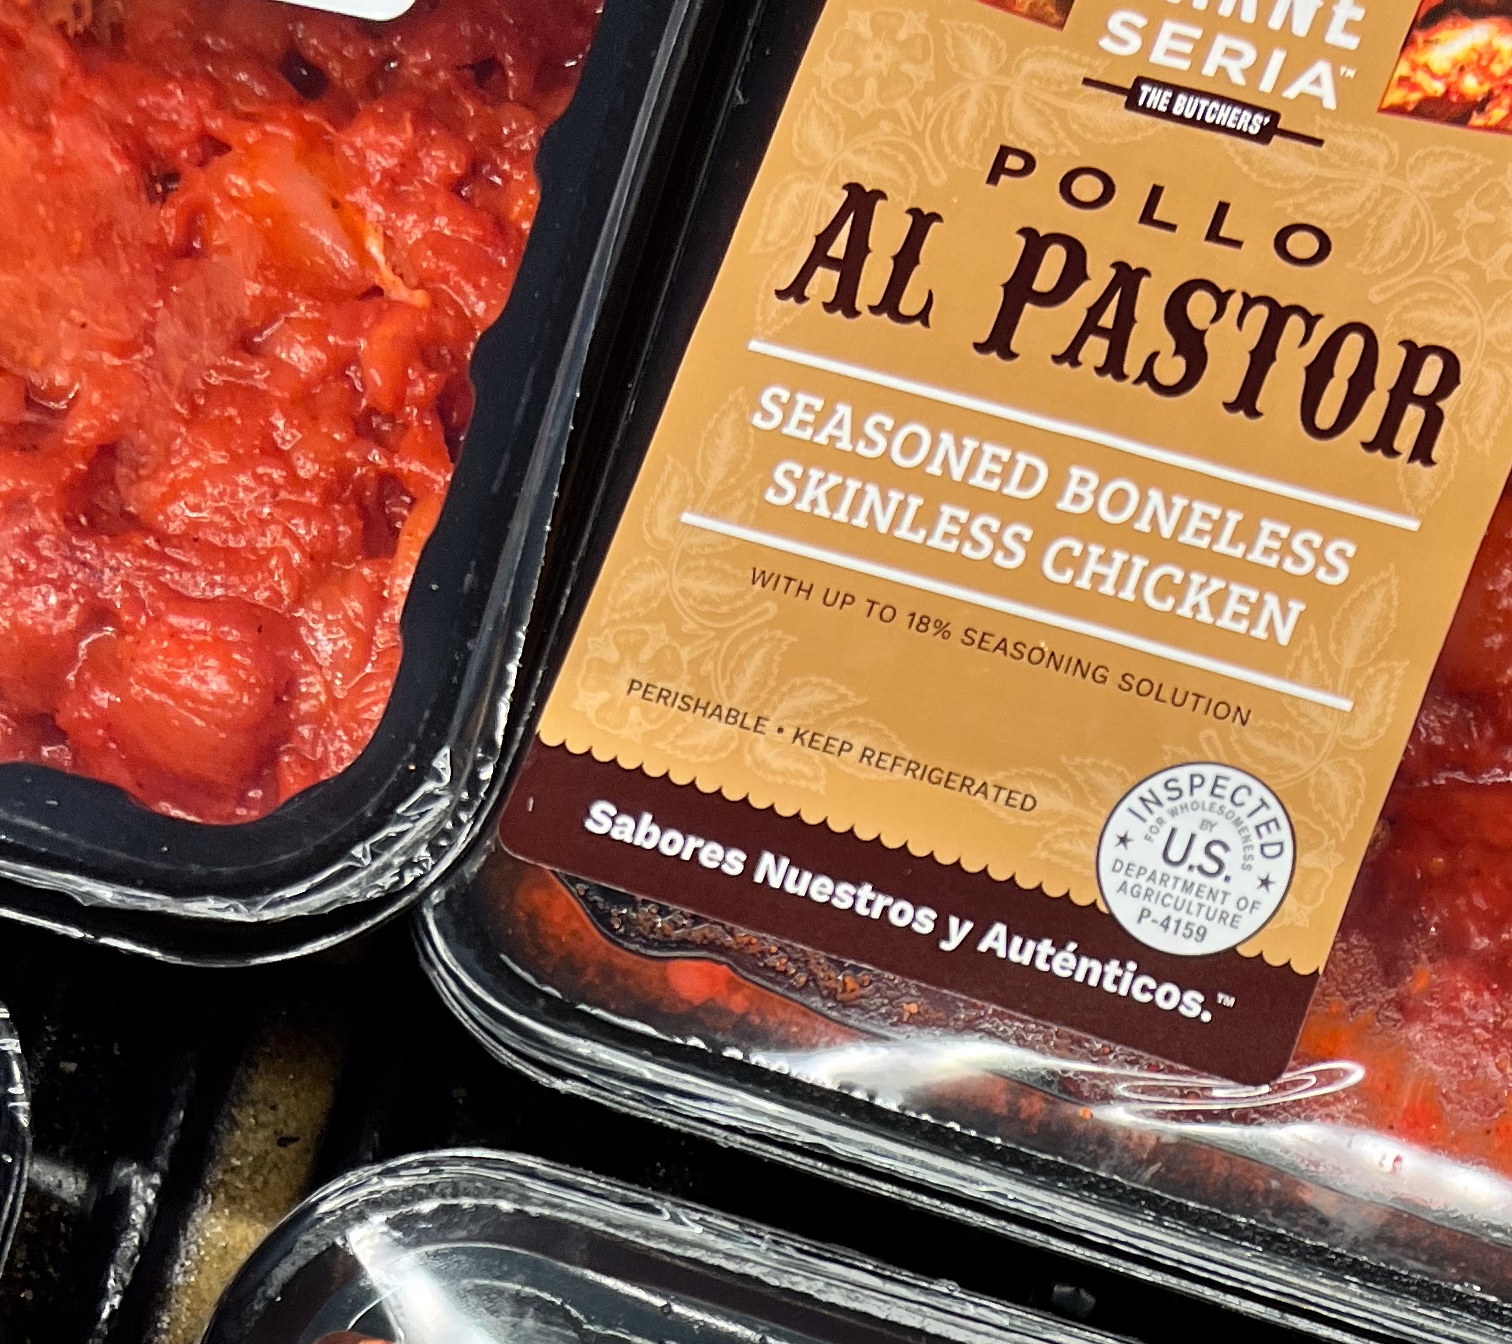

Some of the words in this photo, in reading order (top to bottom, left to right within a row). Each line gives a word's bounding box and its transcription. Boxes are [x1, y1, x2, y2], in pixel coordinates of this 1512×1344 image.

[985, 143, 1332, 267] POLLO
[773, 181, 944, 328] AL
[972, 225, 1461, 467] PASTOR
[749, 384, 1048, 499] SEASONED
[1055, 465, 1356, 585] BONELESS
[763, 459, 1033, 568] SKINLESS
[1041, 536, 1306, 645] CHICKEN
[751, 566, 814, 600] WITH
[821, 587, 855, 610] UP
[866, 598, 897, 623] TO
[907, 611, 951, 640] 18%
[960, 626, 1109, 684] SEASONING
[1117, 671, 1251, 726] SOLUTION
[626, 678, 769, 735] PERISHABLE
[791, 726, 853, 757] KEEP
[858, 745, 1037, 812] REFRIGERATED
[1127, 773, 1284, 859] INSPECTED
[1144, 816, 1167, 843] FOR
[1167, 801, 1254, 872] WHOLESOMENESS
[1162, 827, 1231, 883] U.S.
[1200, 818, 1218, 833] BY
[583, 799, 747, 875] Sabores
[753, 850, 937, 934] Nuestros
[938, 914, 974, 951] y
[1111, 858, 1231, 906] DEPARTMENT
[1236, 897, 1261, 914] OF
[1117, 880, 1242, 929] AGRICULTURE
[1137, 907, 1208, 943] P-4159
